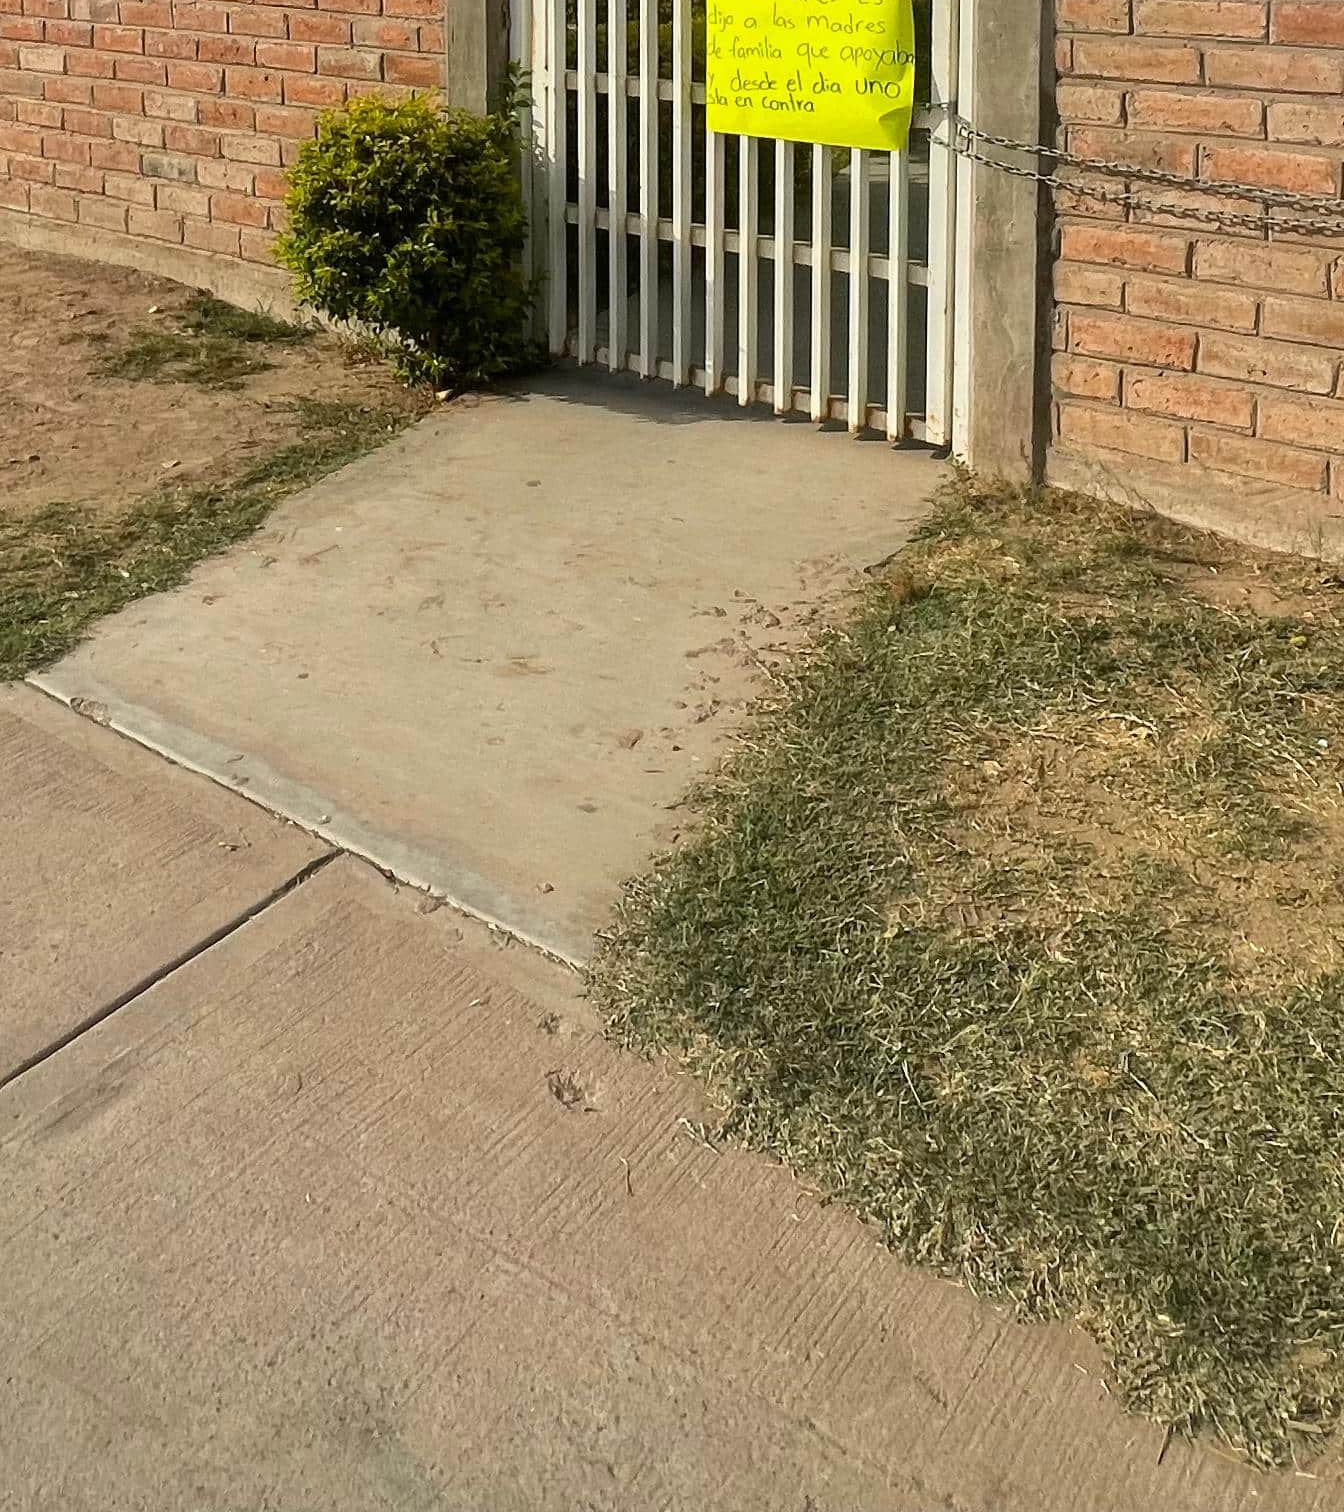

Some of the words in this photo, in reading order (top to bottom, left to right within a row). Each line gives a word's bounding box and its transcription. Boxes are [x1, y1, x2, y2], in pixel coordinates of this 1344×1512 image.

[744, 17, 757, 29] a
[773, 2, 795, 29] las
[807, 13, 885, 34] madres
[729, 36, 782, 59] familia
[797, 42, 829, 68] que
[730, 68, 778, 92] desde
[786, 70, 803, 92] el
[855, 77, 901, 99] uno
[734, 95, 753, 108] en
[762, 93, 815, 113] contra
